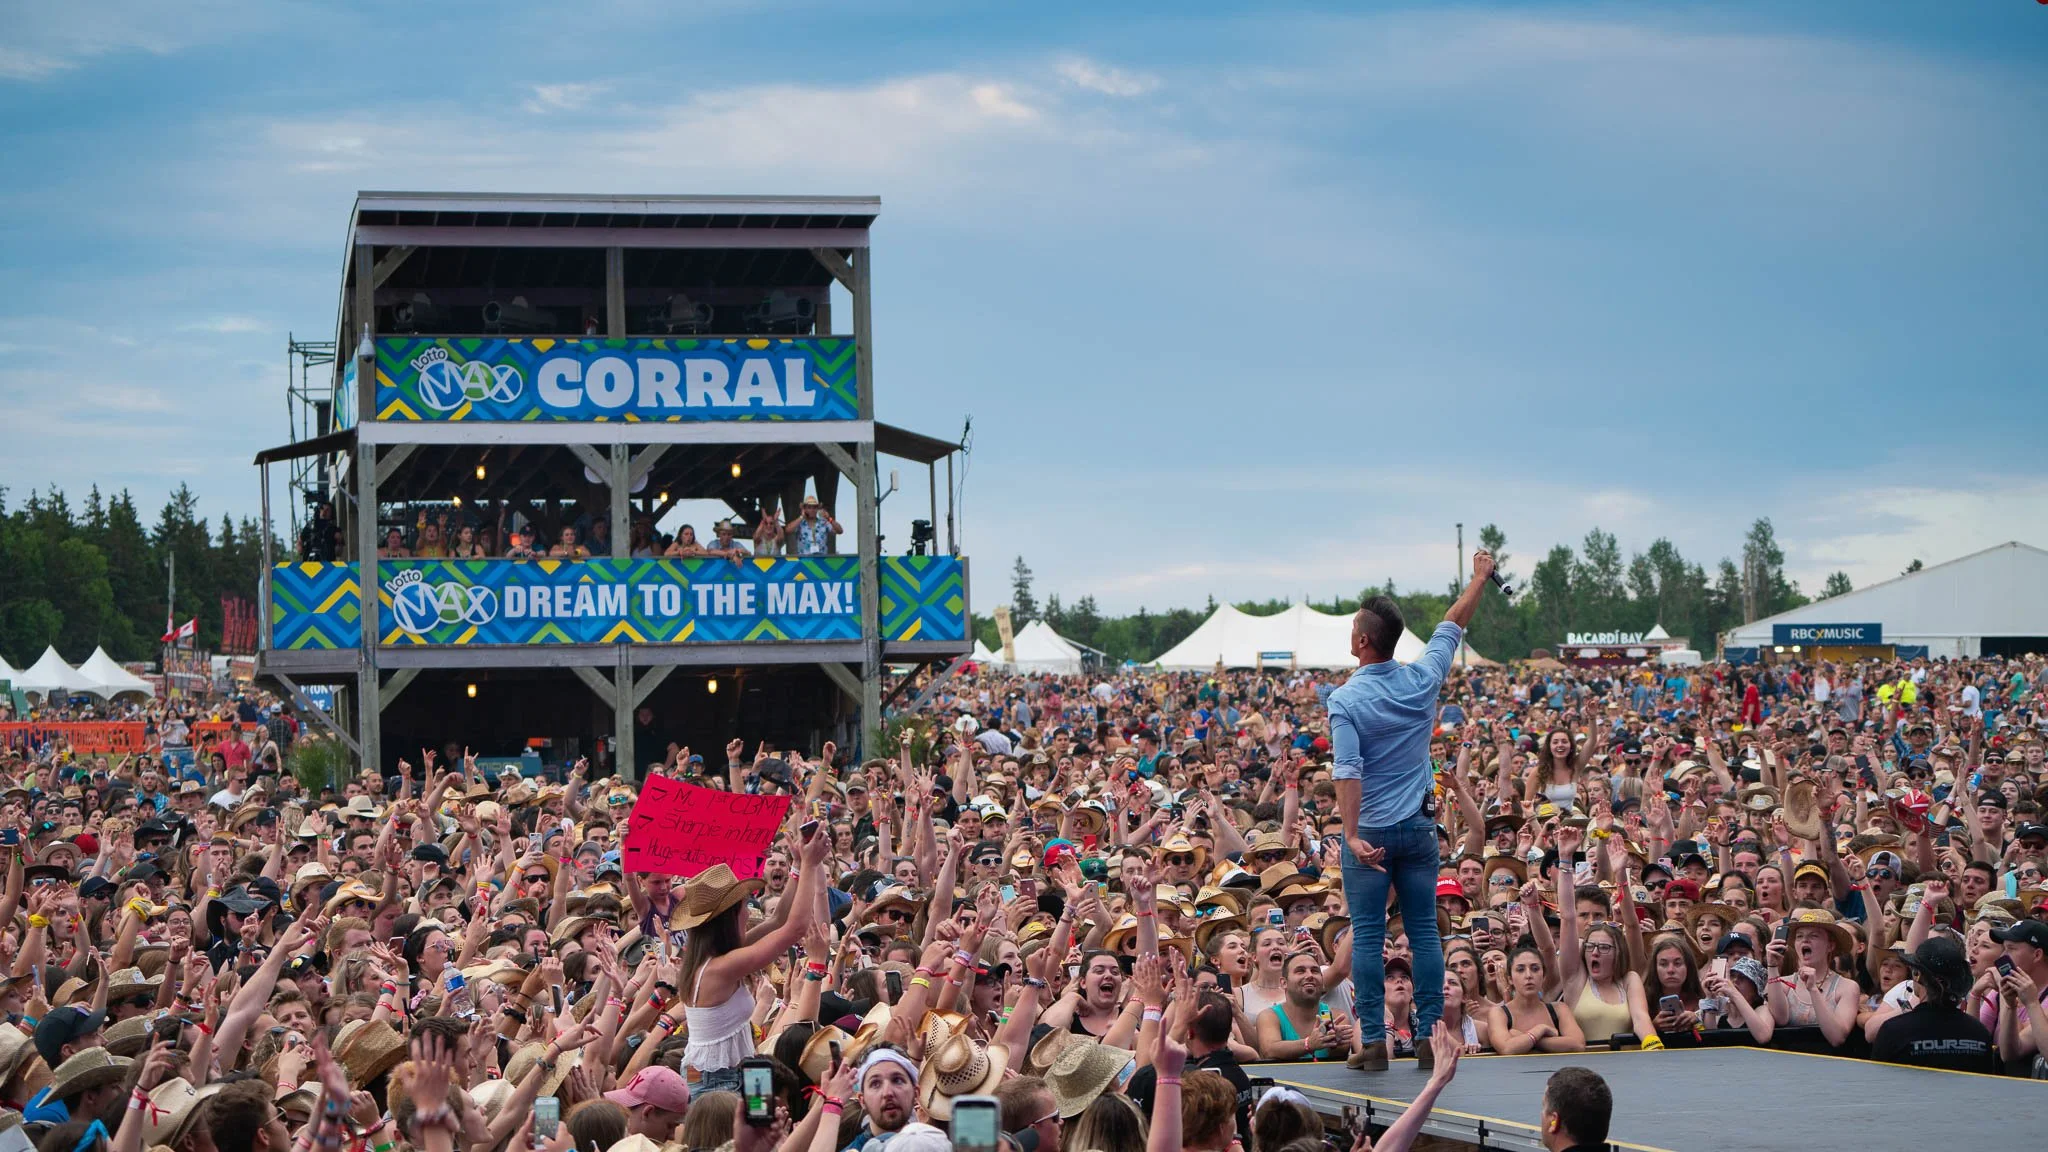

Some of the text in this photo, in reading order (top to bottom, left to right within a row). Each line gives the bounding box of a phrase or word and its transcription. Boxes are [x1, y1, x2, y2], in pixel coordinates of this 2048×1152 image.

[413, 348, 447, 370] Lotto
[419, 356, 816, 411] MAX CORRAL
[386, 570, 421, 592] Lotto
[393, 582, 853, 634] MAX DREAM TO THE MAX!
[1620, 632, 1643, 644] BAY
[1437, 878, 1456, 886] anada
[1911, 1039, 1987, 1052] TOURSEC
